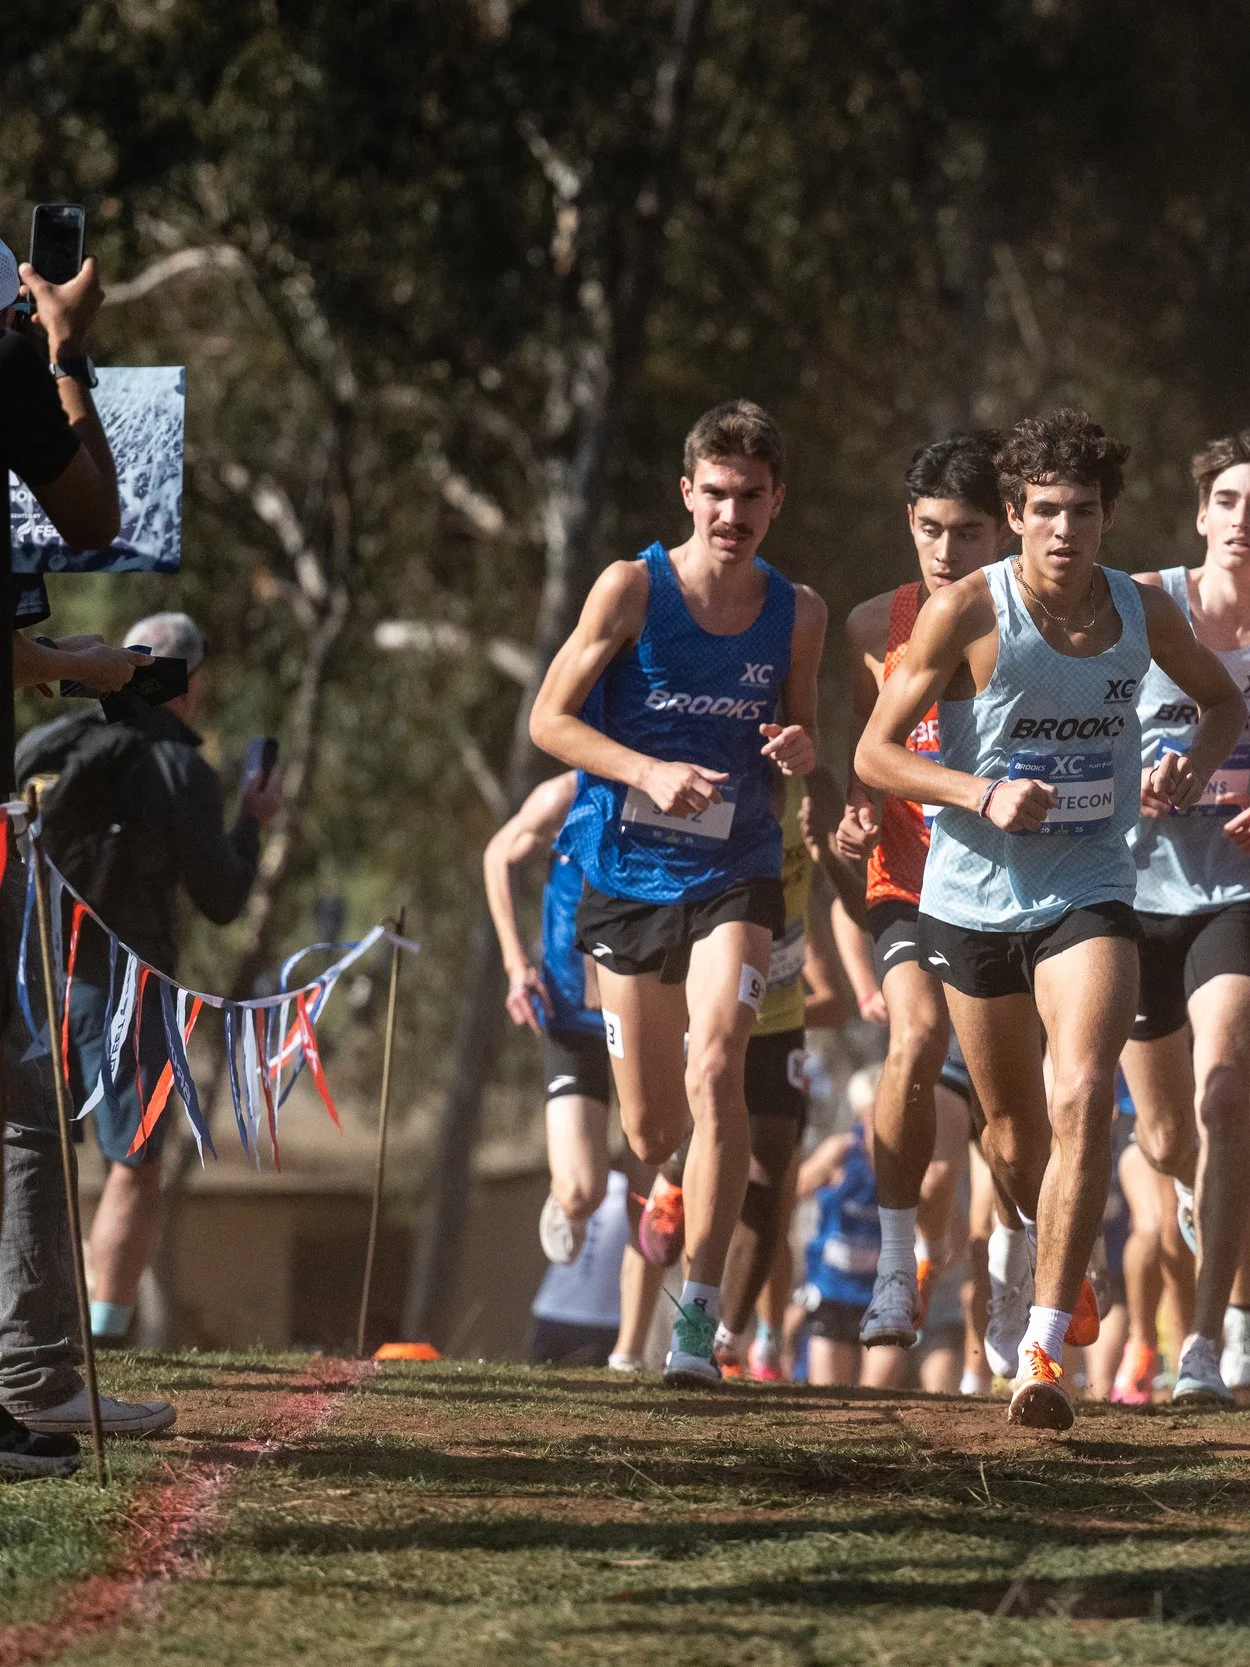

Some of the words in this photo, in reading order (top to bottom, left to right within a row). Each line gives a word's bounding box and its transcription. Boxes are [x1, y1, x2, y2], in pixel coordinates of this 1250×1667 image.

[740, 662, 774, 684] XC
[1104, 679, 1137, 700] XC
[644, 689, 767, 720] BROOKS
[1010, 716, 1125, 741] BROOKS
[1014, 763, 1046, 771] BROOKS
[1050, 756, 1086, 774] XC
[1057, 791, 1112, 809] TECON
